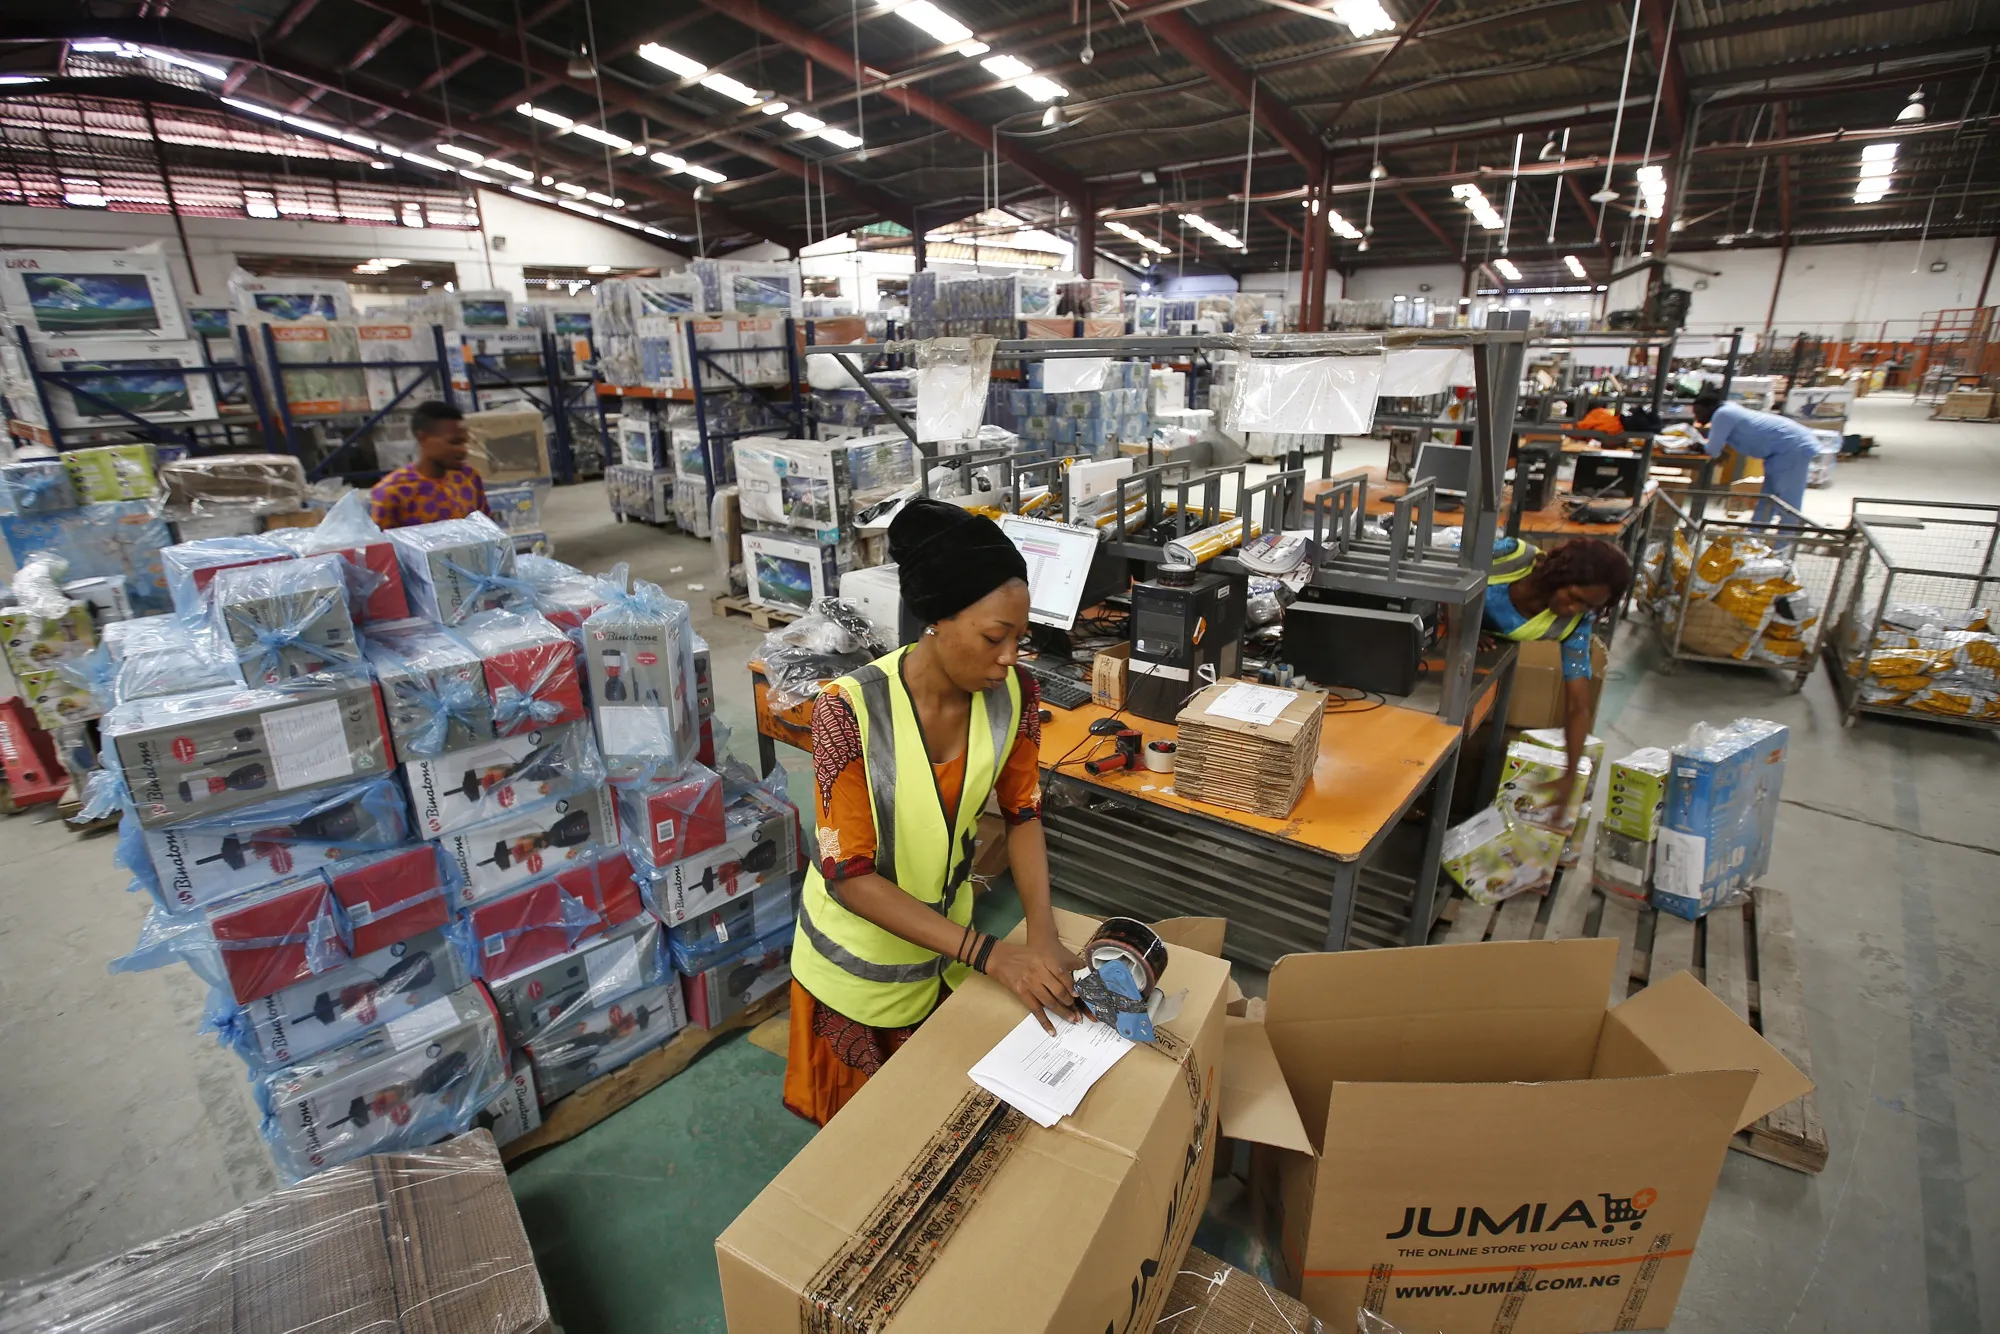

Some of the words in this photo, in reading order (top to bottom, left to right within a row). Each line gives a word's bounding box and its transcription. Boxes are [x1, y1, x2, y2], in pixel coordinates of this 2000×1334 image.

[444, 552, 463, 607] Binatoe
[606, 631, 658, 642] Binatone
[138, 740, 165, 802] Binatone
[420, 761, 440, 819] Binatone
[164, 829, 193, 889] Binaton
[674, 865, 685, 909] Binaton
[263, 994, 288, 1050] Binaton
[1386, 1199, 1598, 1239] JUMIA
[1398, 1248, 1424, 1257] THE
[1428, 1246, 1477, 1257] ONLINE
[1482, 1243, 1526, 1255] STORE
[1530, 1241, 1557, 1252] YOU
[1561, 1239, 1588, 1250] CAN
[1593, 1236, 1634, 1248] TRUST
[821, 1251, 858, 1293] JUMIA
[1395, 1274, 1621, 1299] WWW.JUMIA.COM.NG
